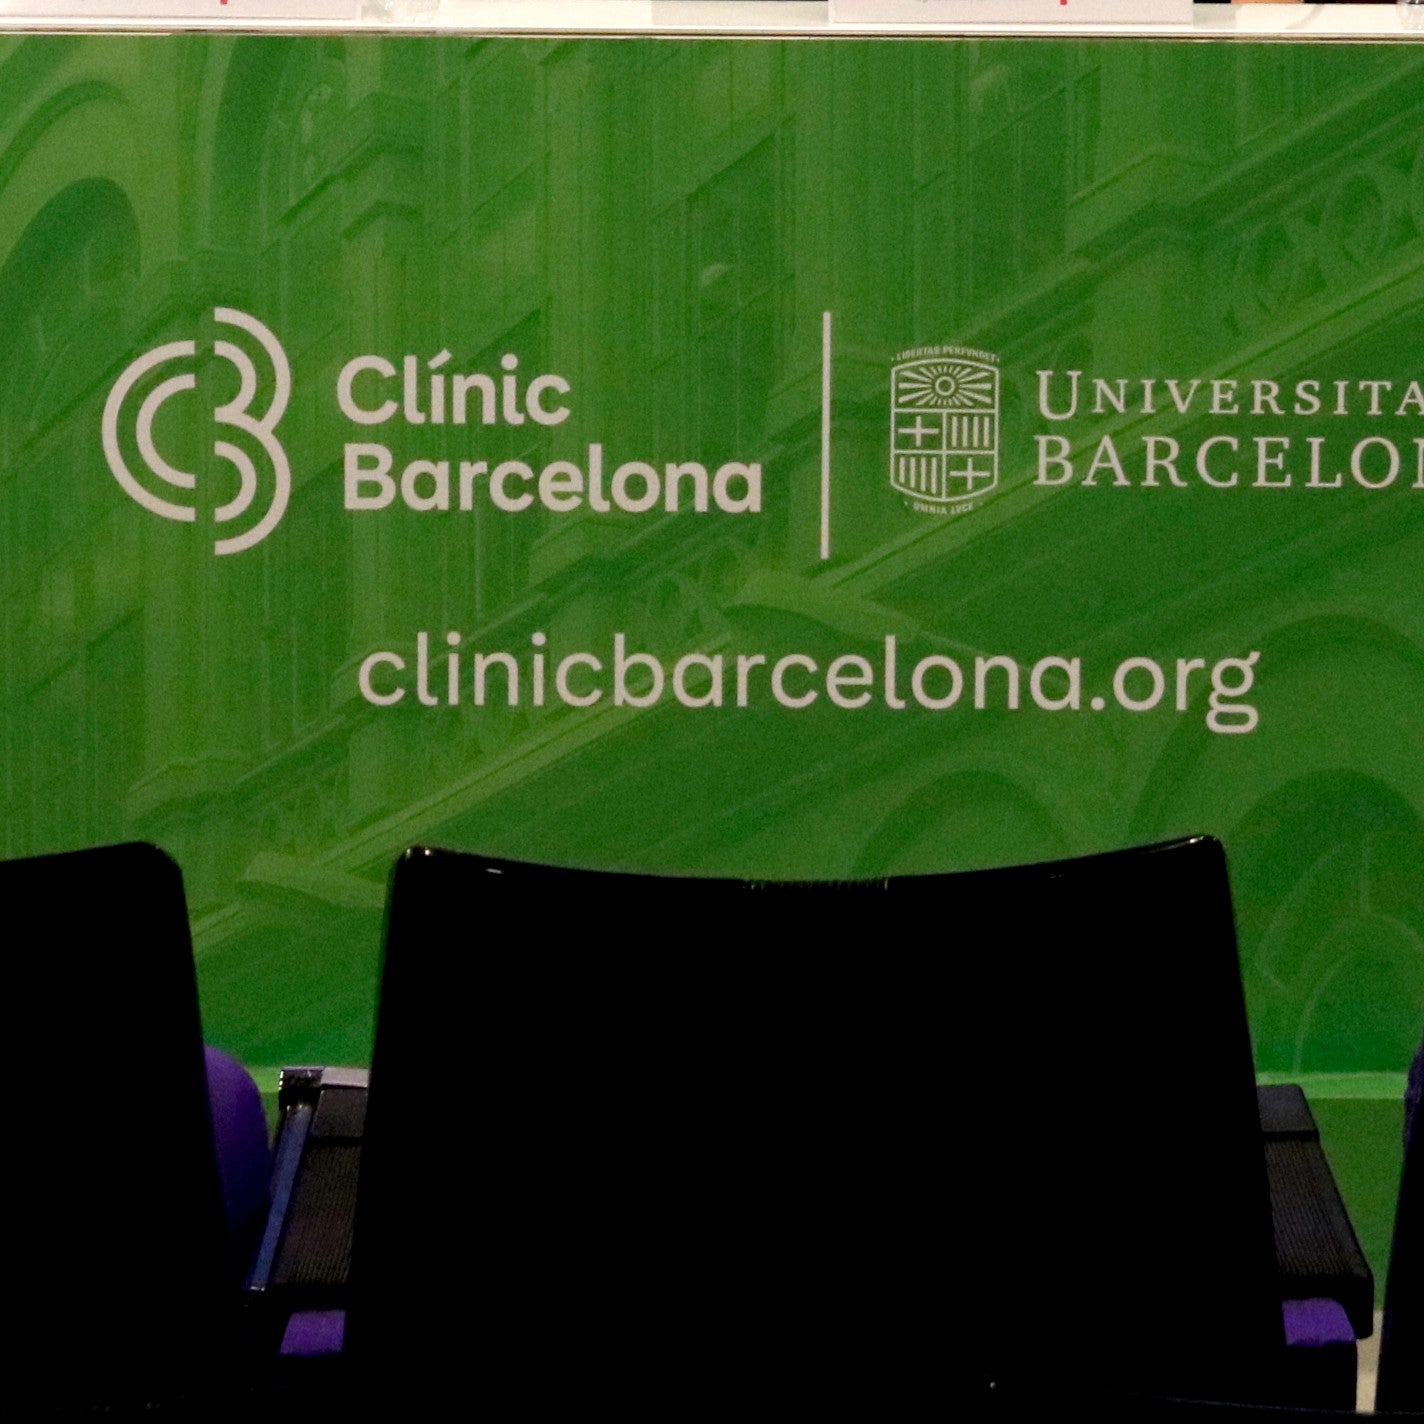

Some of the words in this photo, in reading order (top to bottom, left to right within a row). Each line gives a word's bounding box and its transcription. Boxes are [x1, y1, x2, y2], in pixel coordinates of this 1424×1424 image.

[337, 348, 570, 426] Clínic
[343, 441, 761, 513] Barcelona
[358, 630, 1260, 734] clinicbarcelona.org
